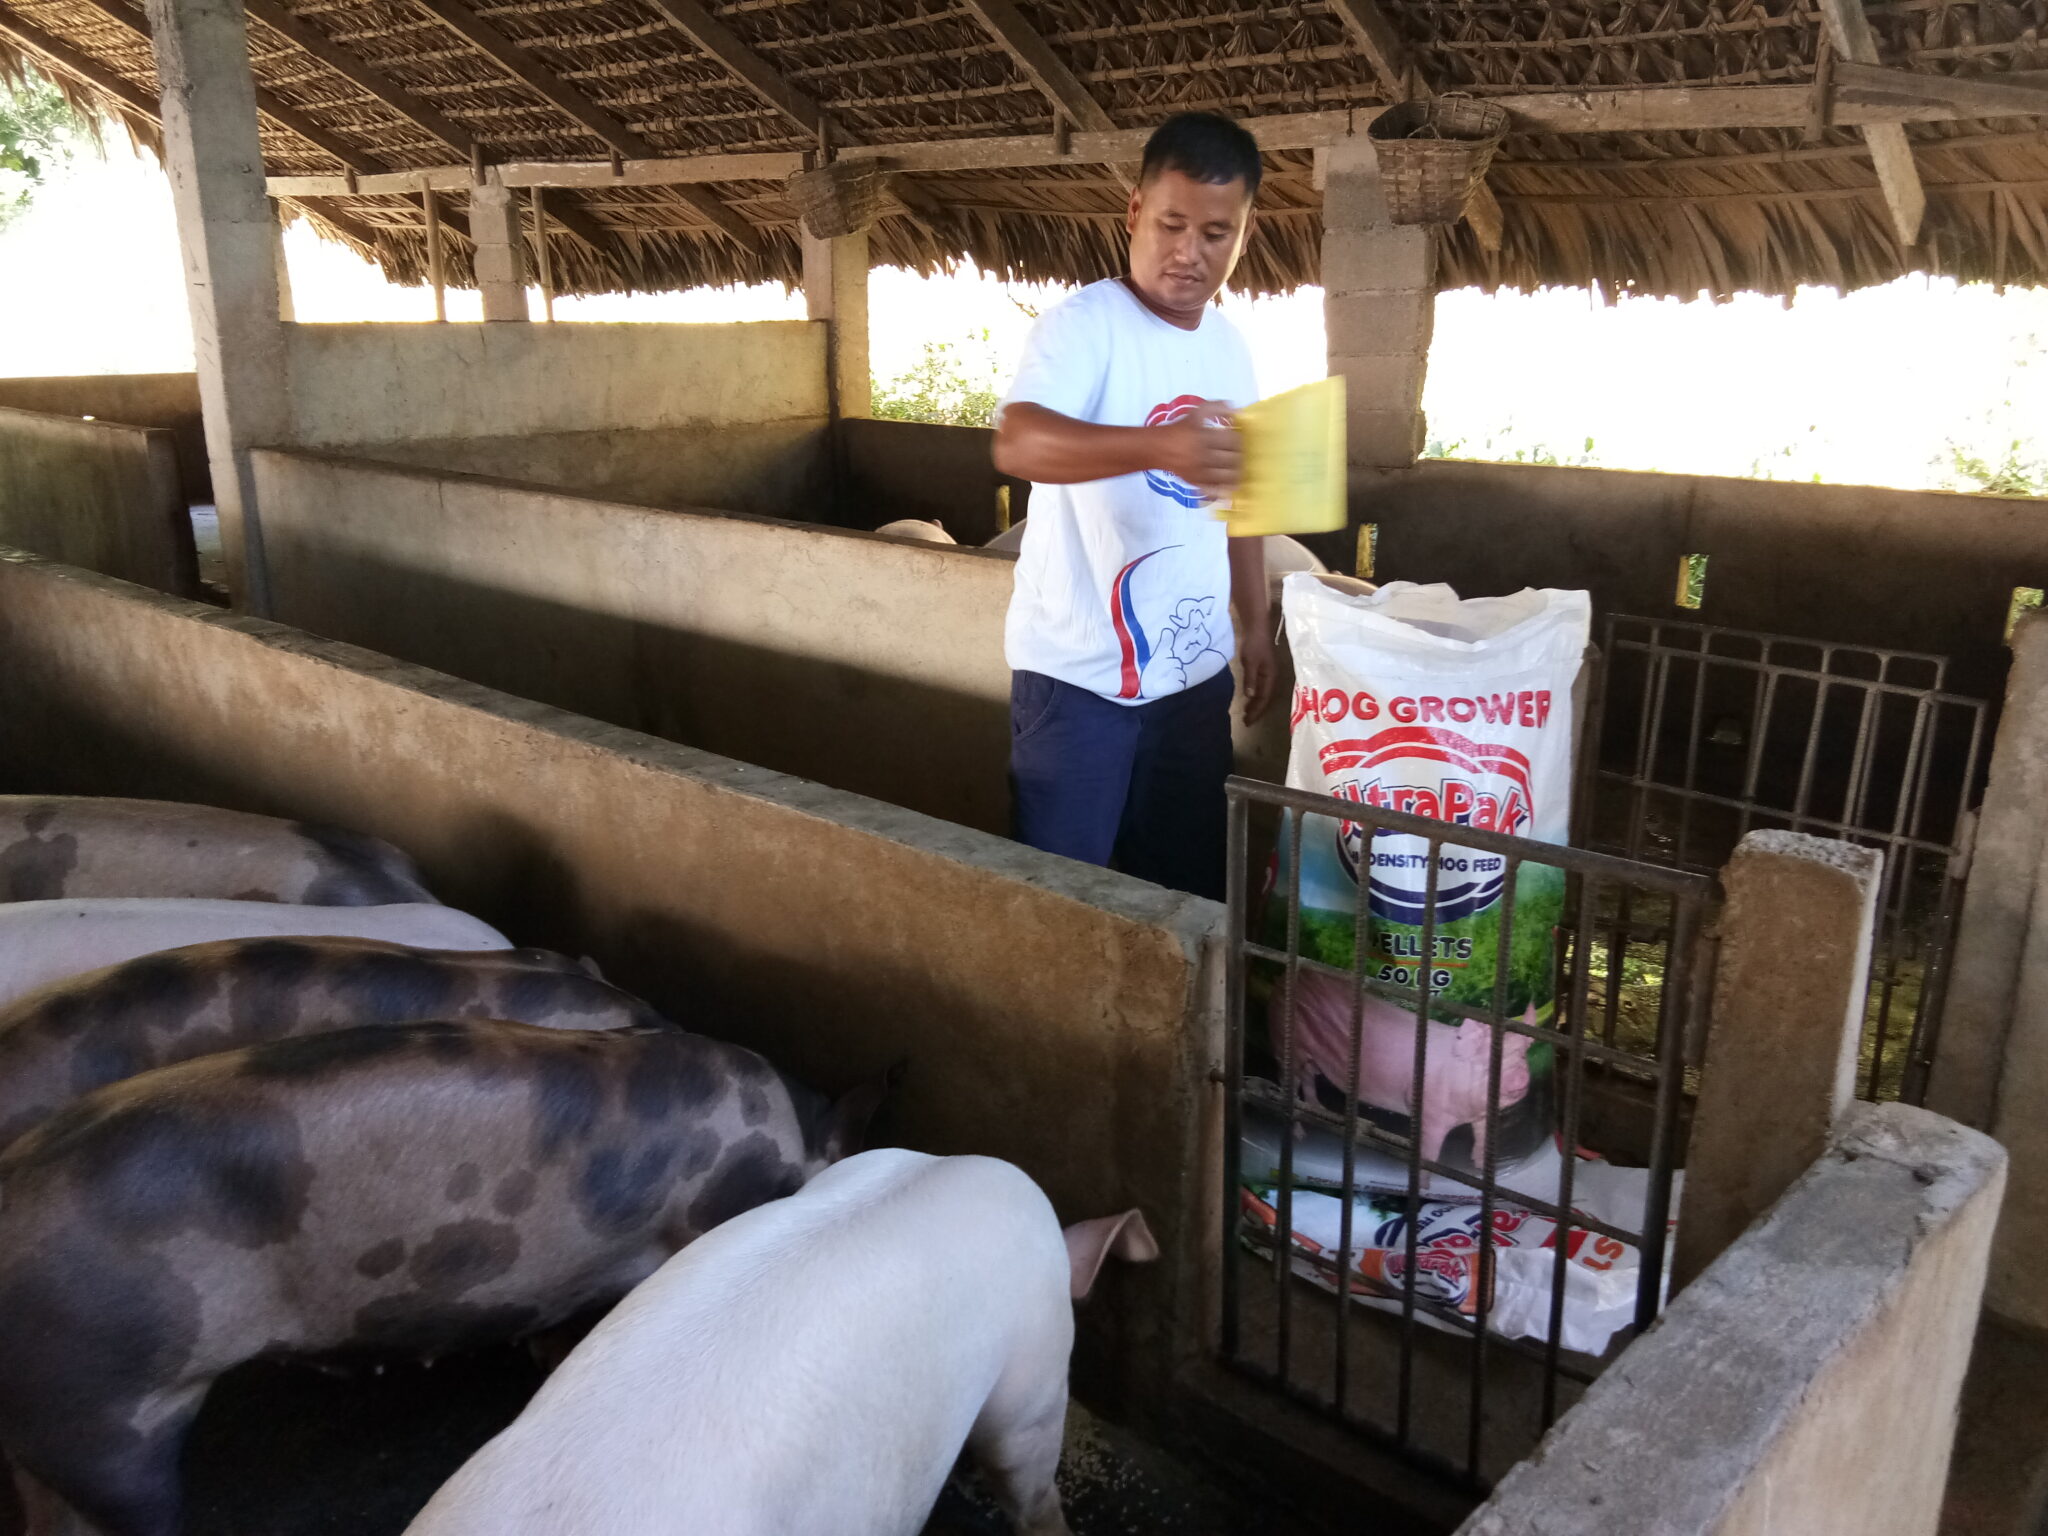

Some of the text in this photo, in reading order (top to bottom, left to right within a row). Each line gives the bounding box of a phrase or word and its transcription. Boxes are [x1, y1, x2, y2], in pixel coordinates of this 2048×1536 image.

[1301, 686, 1552, 729] HOG GROWER
[1473, 857, 1501, 872] FEED
